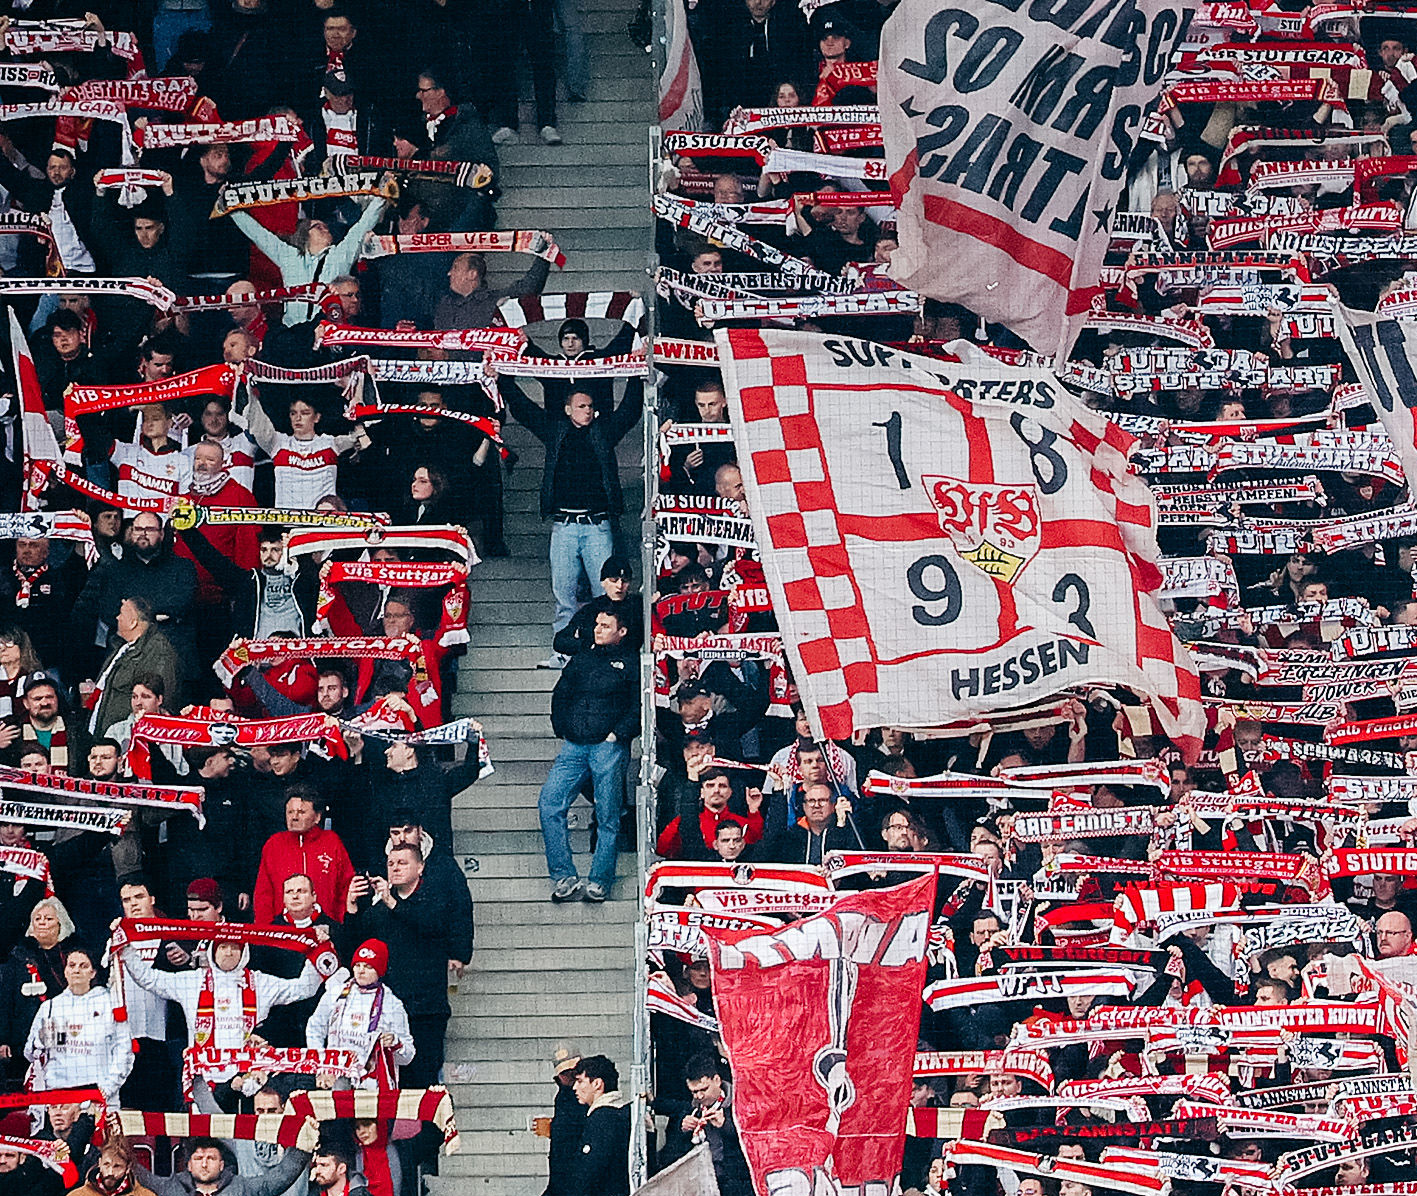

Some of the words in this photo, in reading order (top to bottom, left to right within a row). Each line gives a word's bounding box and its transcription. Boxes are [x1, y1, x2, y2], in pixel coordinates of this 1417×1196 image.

[1243, 48, 1355, 67] STUTTGART
[225, 173, 376, 209] STUTTGART
[411, 234, 451, 247] SUPER
[71, 384, 97, 405] VfB
[100, 374, 199, 401] STUTTGART
[1010, 412, 1067, 495] 8
[344, 566, 372, 582] VfB
[376, 566, 454, 582] Stuttgart
[907, 554, 962, 627] 9
[951, 637, 1091, 701] HESSEN
[716, 892, 748, 908] VfB
[753, 891, 838, 908] Stuttgart
[1327, 1008, 1376, 1028] KURVE
